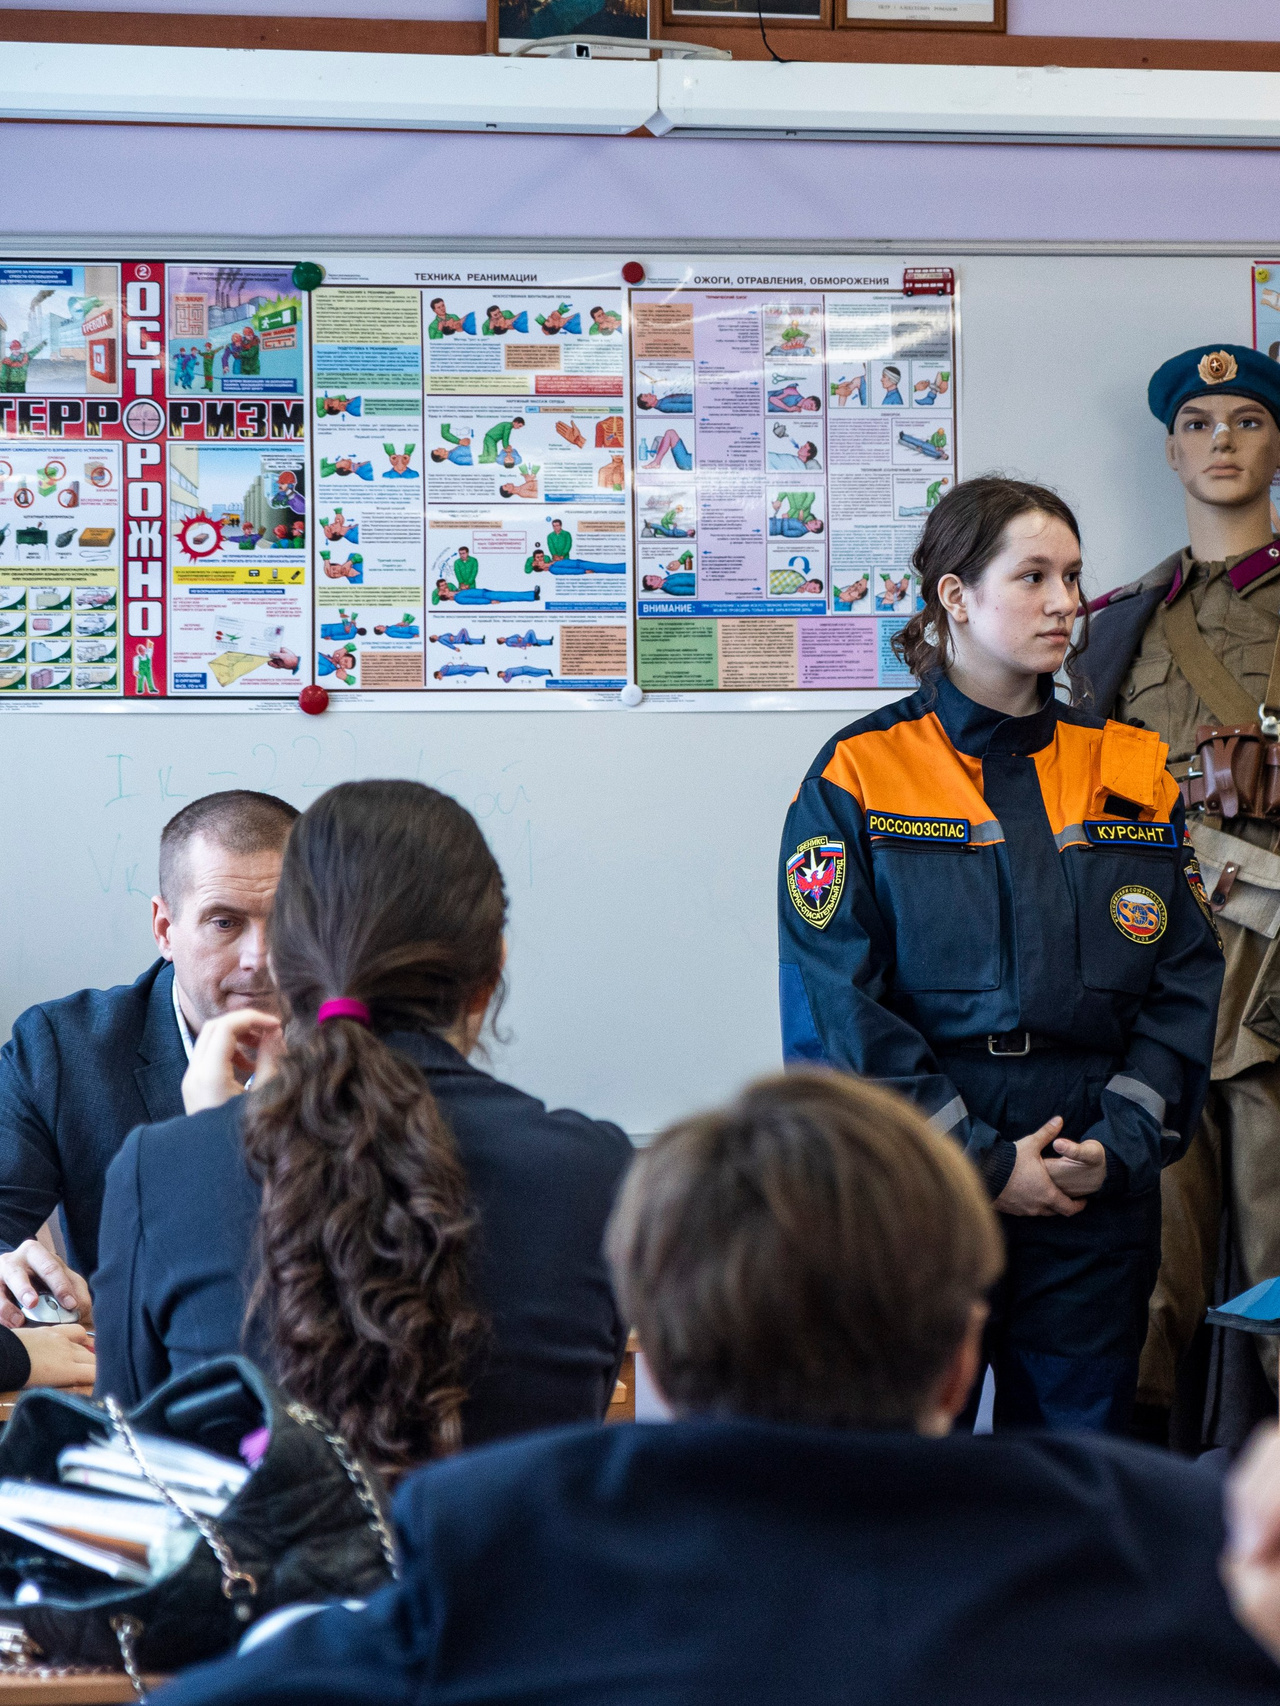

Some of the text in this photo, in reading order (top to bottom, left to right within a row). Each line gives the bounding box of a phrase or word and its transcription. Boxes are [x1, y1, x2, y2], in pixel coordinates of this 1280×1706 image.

[138, 267, 148, 277] 2
[414, 272, 538, 283] ТЕХНИКА РЕАНИМАЦИИ
[694, 276, 890, 286] ОЖОГИ, ОТРАВЛЕНИЯ, ОБМОРОЖЕНИЯ
[642, 603, 696, 613] ВНИМАНИЕ:
[869, 815, 965, 838] РОССОЮЗСПАС
[1097, 826, 1166, 842] КУРСАНТ
[798, 838, 827, 852] ФЕНИКС
[788, 859, 844, 920] ПОЖАРНО-СПАСАТЕЛЬНЫЙ ОТРЯД
